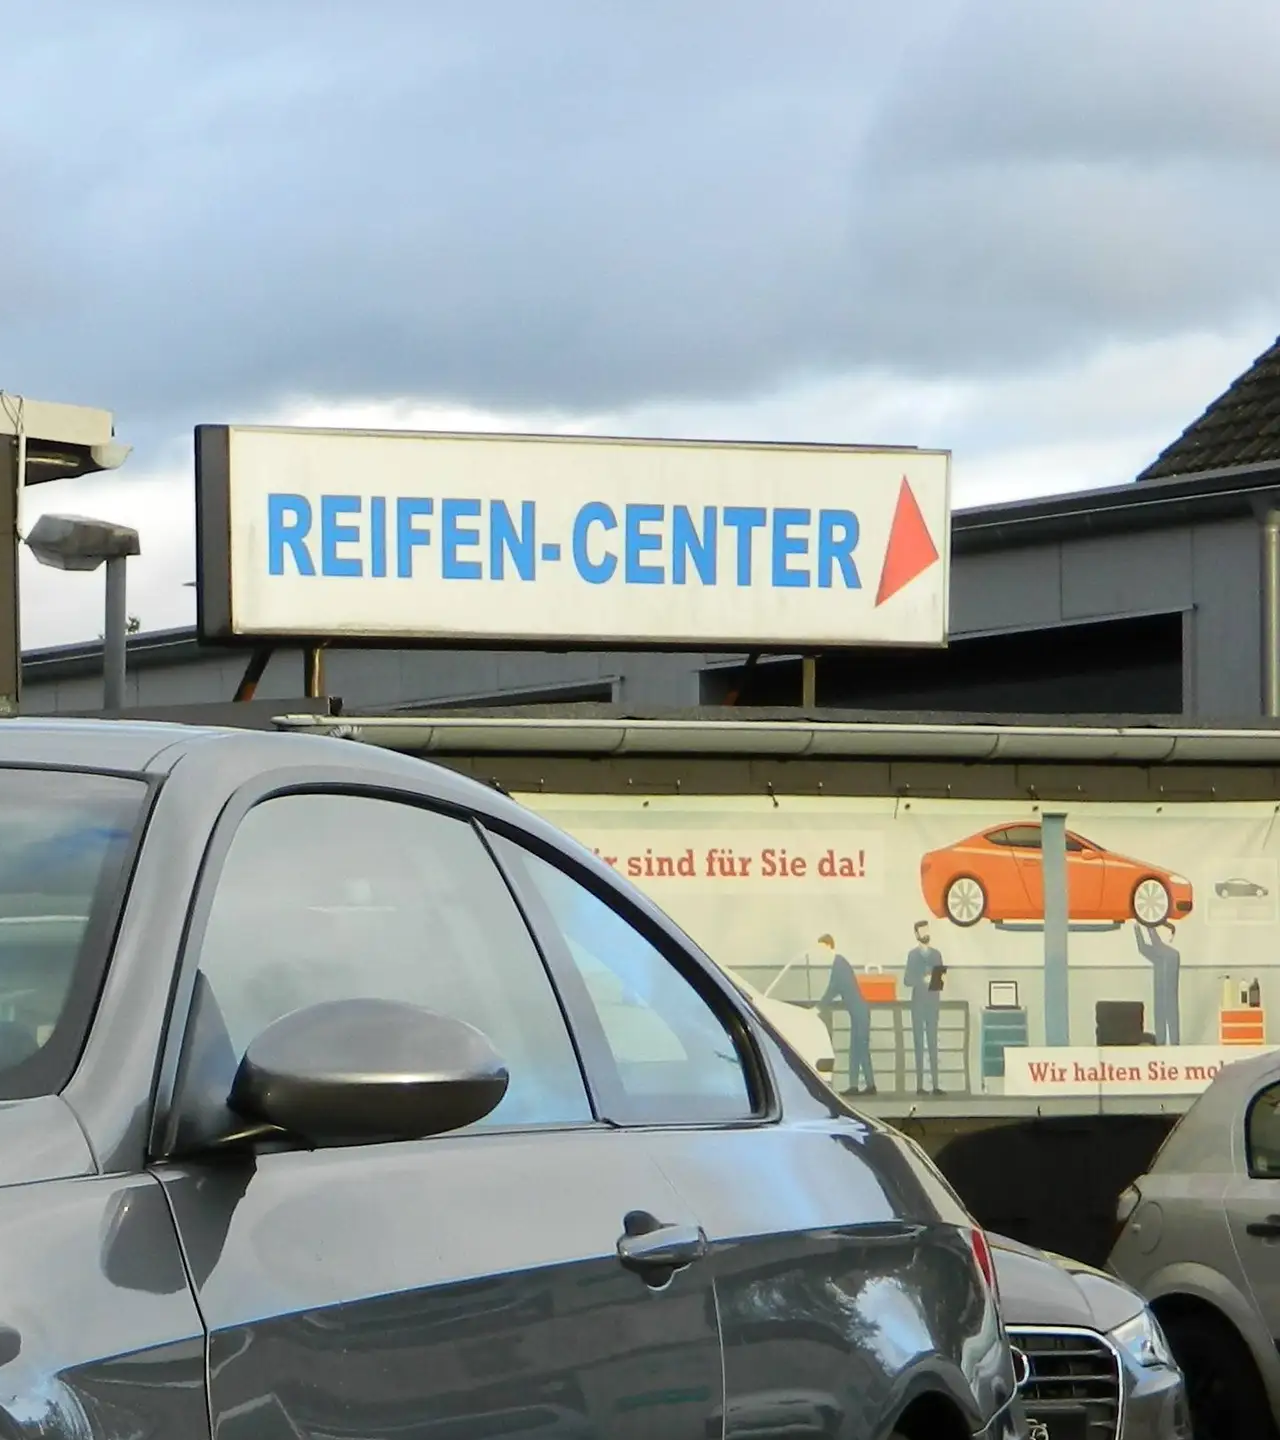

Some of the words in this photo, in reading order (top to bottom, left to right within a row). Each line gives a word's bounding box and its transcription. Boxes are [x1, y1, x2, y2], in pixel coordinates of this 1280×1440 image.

[267, 492, 863, 590] REIFEN-CENTER
[627, 847, 697, 877] sind
[705, 847, 752, 877] für
[760, 848, 807, 877] Sie
[816, 848, 866, 877] da!
[1028, 1061, 1067, 1082] Wir
[1073, 1061, 1141, 1082] halten
[1147, 1060, 1179, 1081] Sie
